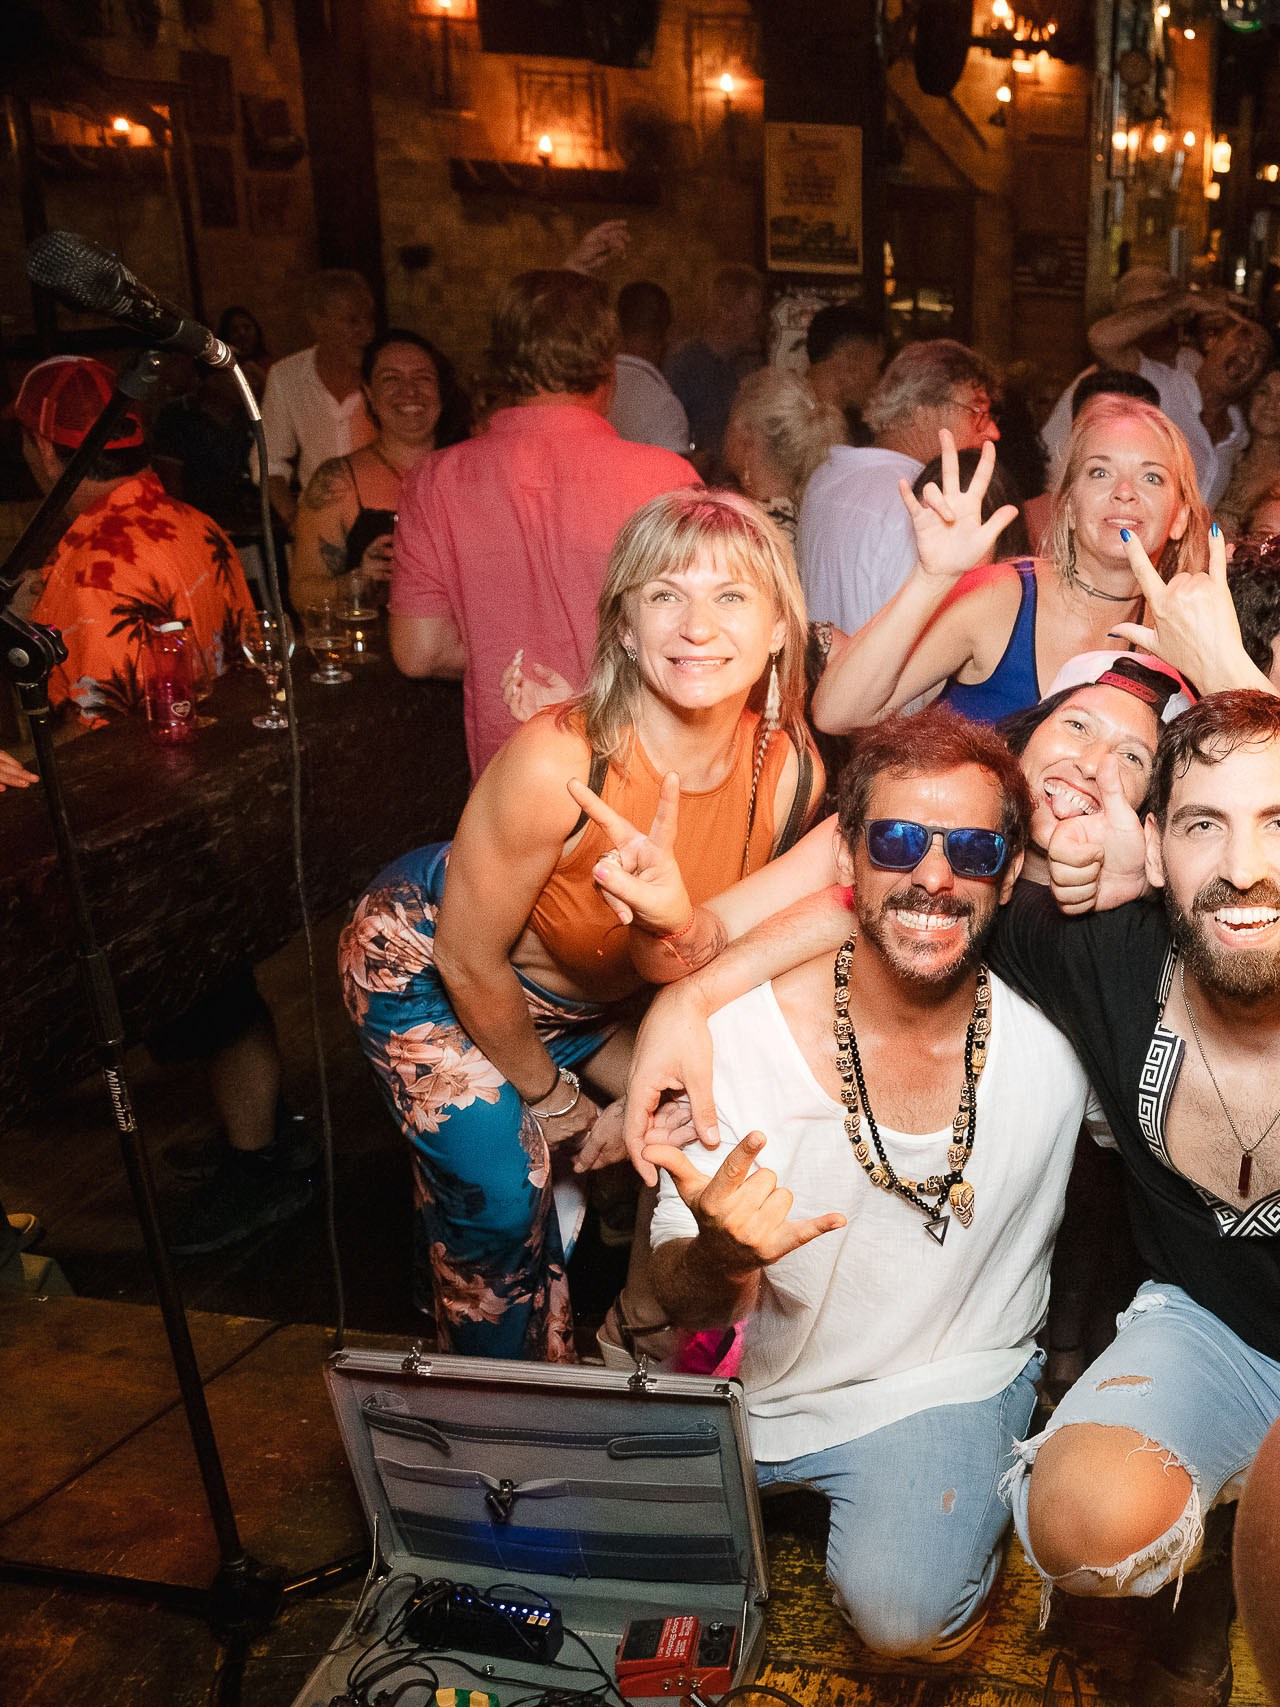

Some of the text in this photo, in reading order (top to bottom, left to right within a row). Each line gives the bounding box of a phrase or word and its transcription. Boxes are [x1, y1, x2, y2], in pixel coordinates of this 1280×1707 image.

[105, 1069, 128, 1131] Millenium
[671, 1617, 682, 1634] Loop
[664, 1633, 677, 1658] Station
